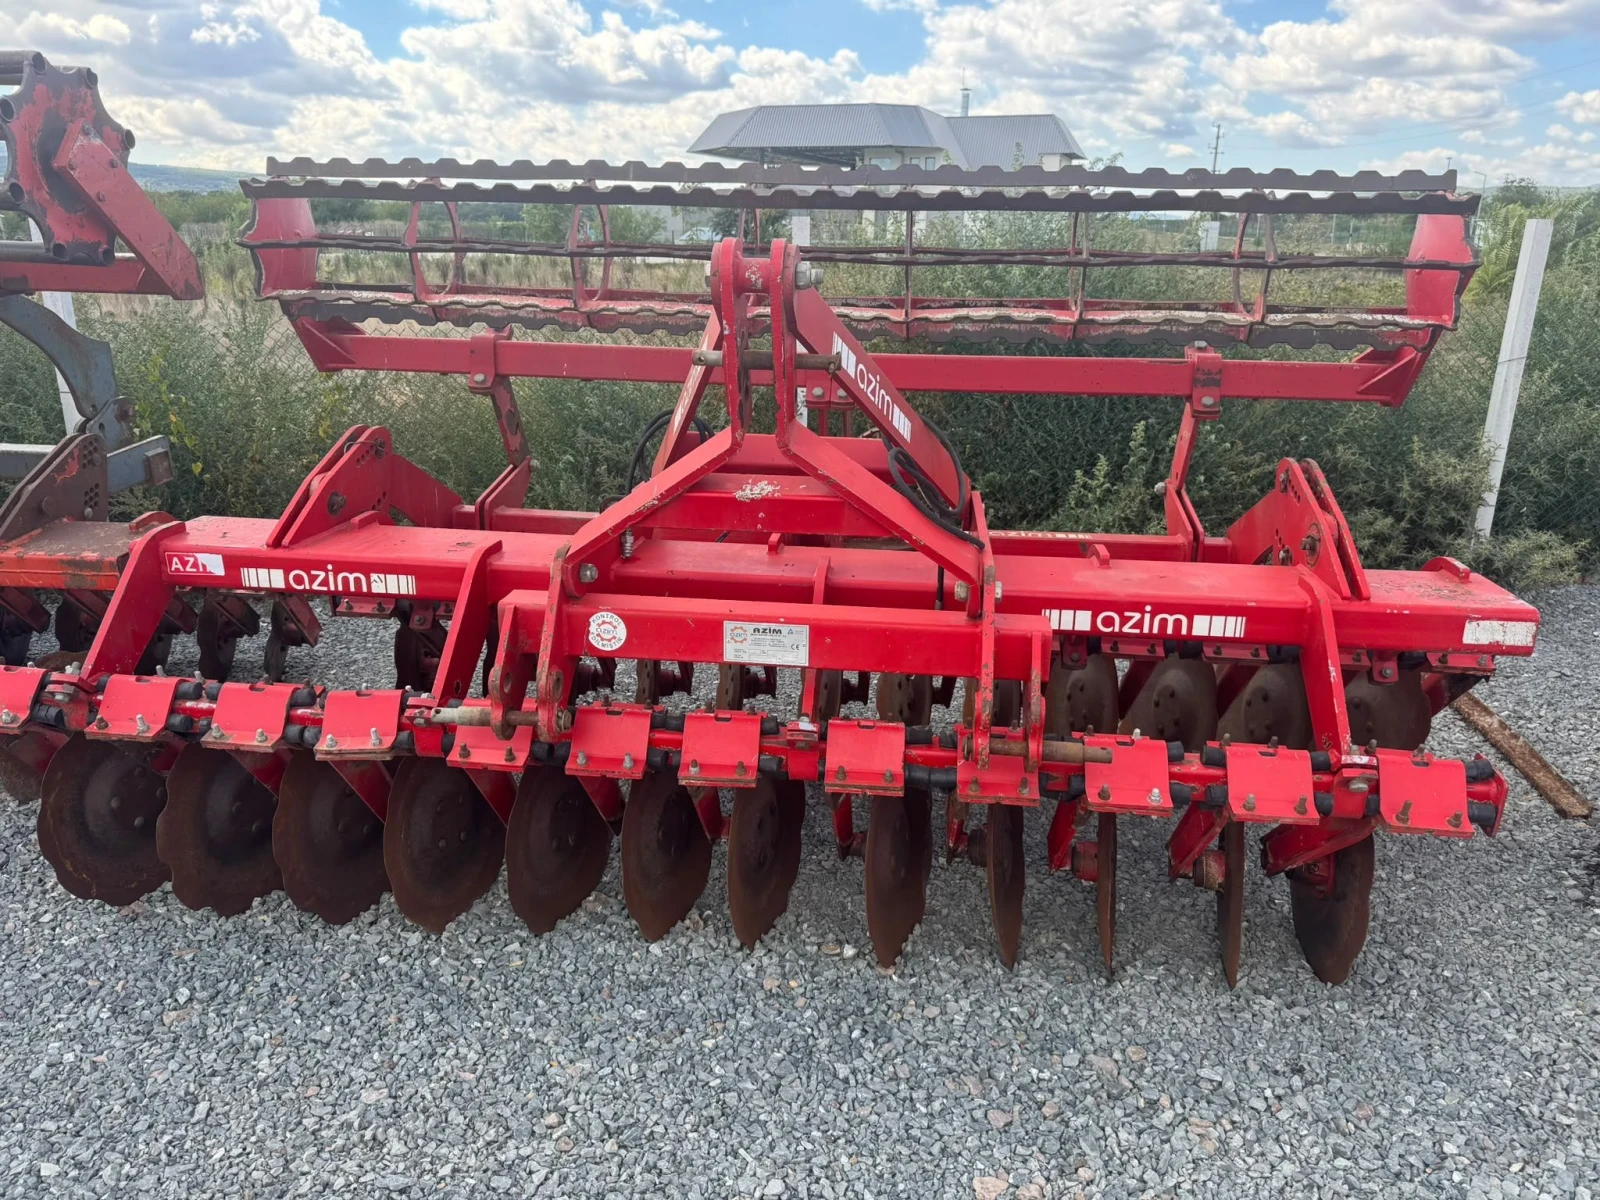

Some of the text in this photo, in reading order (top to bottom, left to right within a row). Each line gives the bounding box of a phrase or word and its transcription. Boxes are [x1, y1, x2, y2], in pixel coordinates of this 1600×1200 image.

[857, 363, 892, 421] azim
[288, 563, 368, 592] azim
[591, 613, 622, 626] KONTROL
[753, 627, 783, 635] AZİM
[1096, 604, 1188, 635] azim
